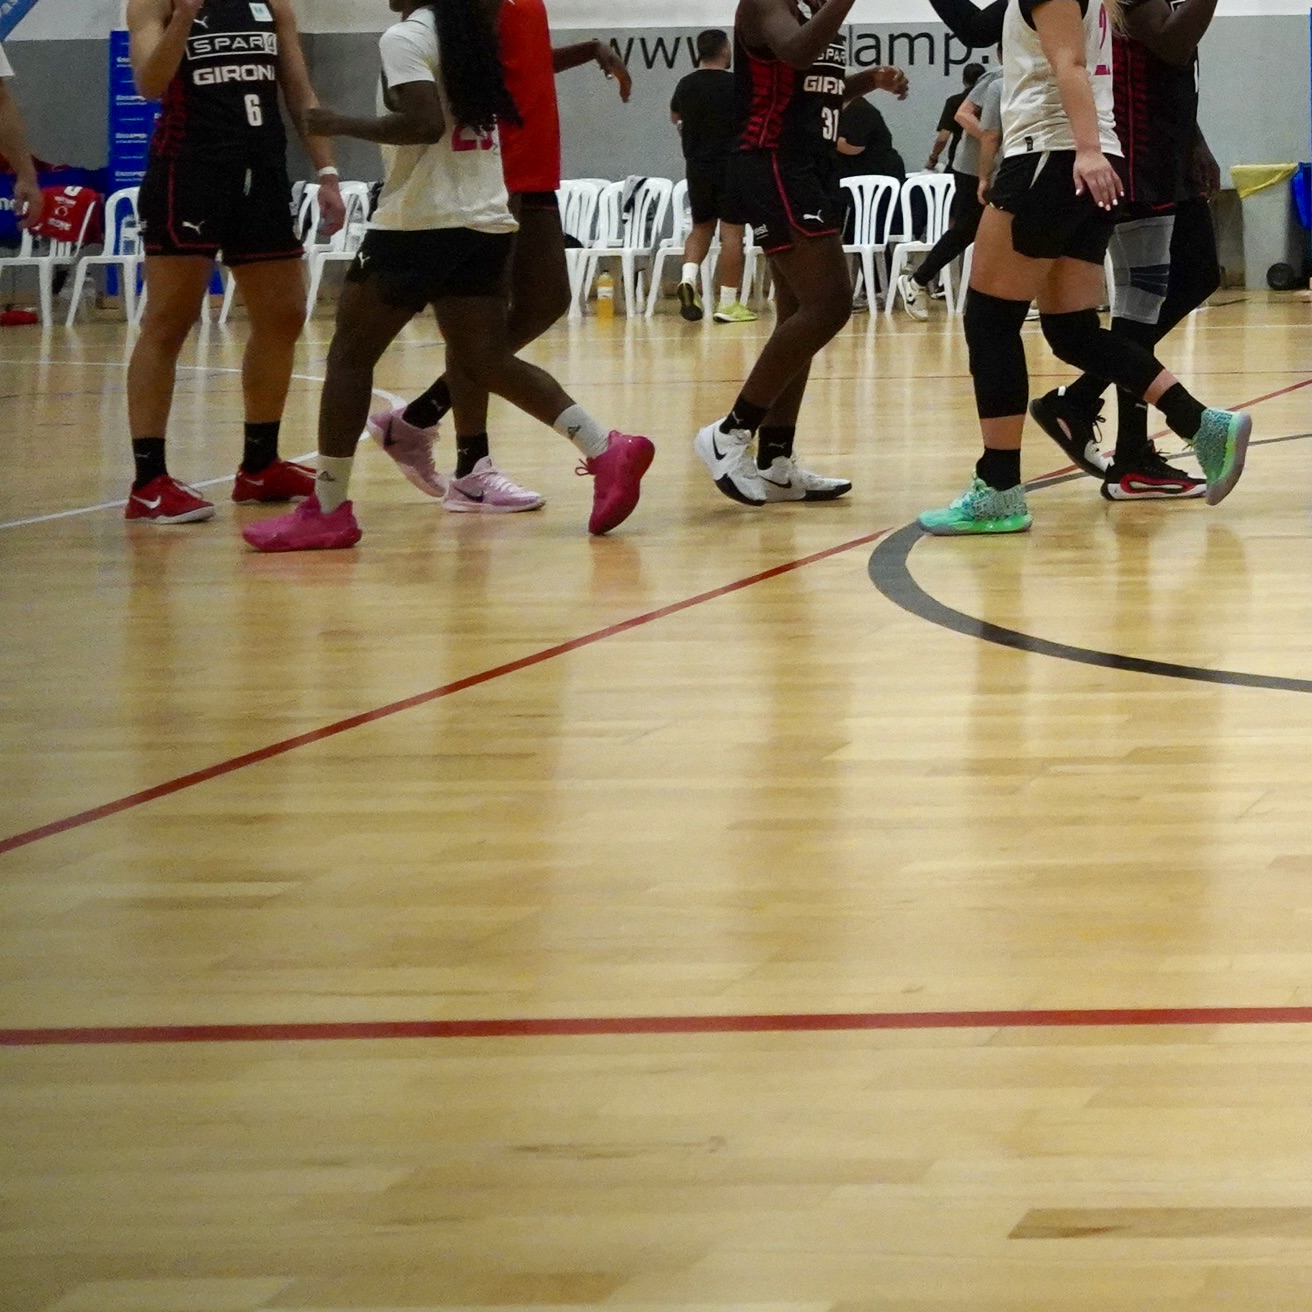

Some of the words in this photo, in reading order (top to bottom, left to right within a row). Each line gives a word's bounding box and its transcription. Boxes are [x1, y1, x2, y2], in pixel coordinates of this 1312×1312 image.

[193, 36, 264, 53] SPAR
[244, 94, 263, 126] 6
[821, 106, 839, 141] 31
